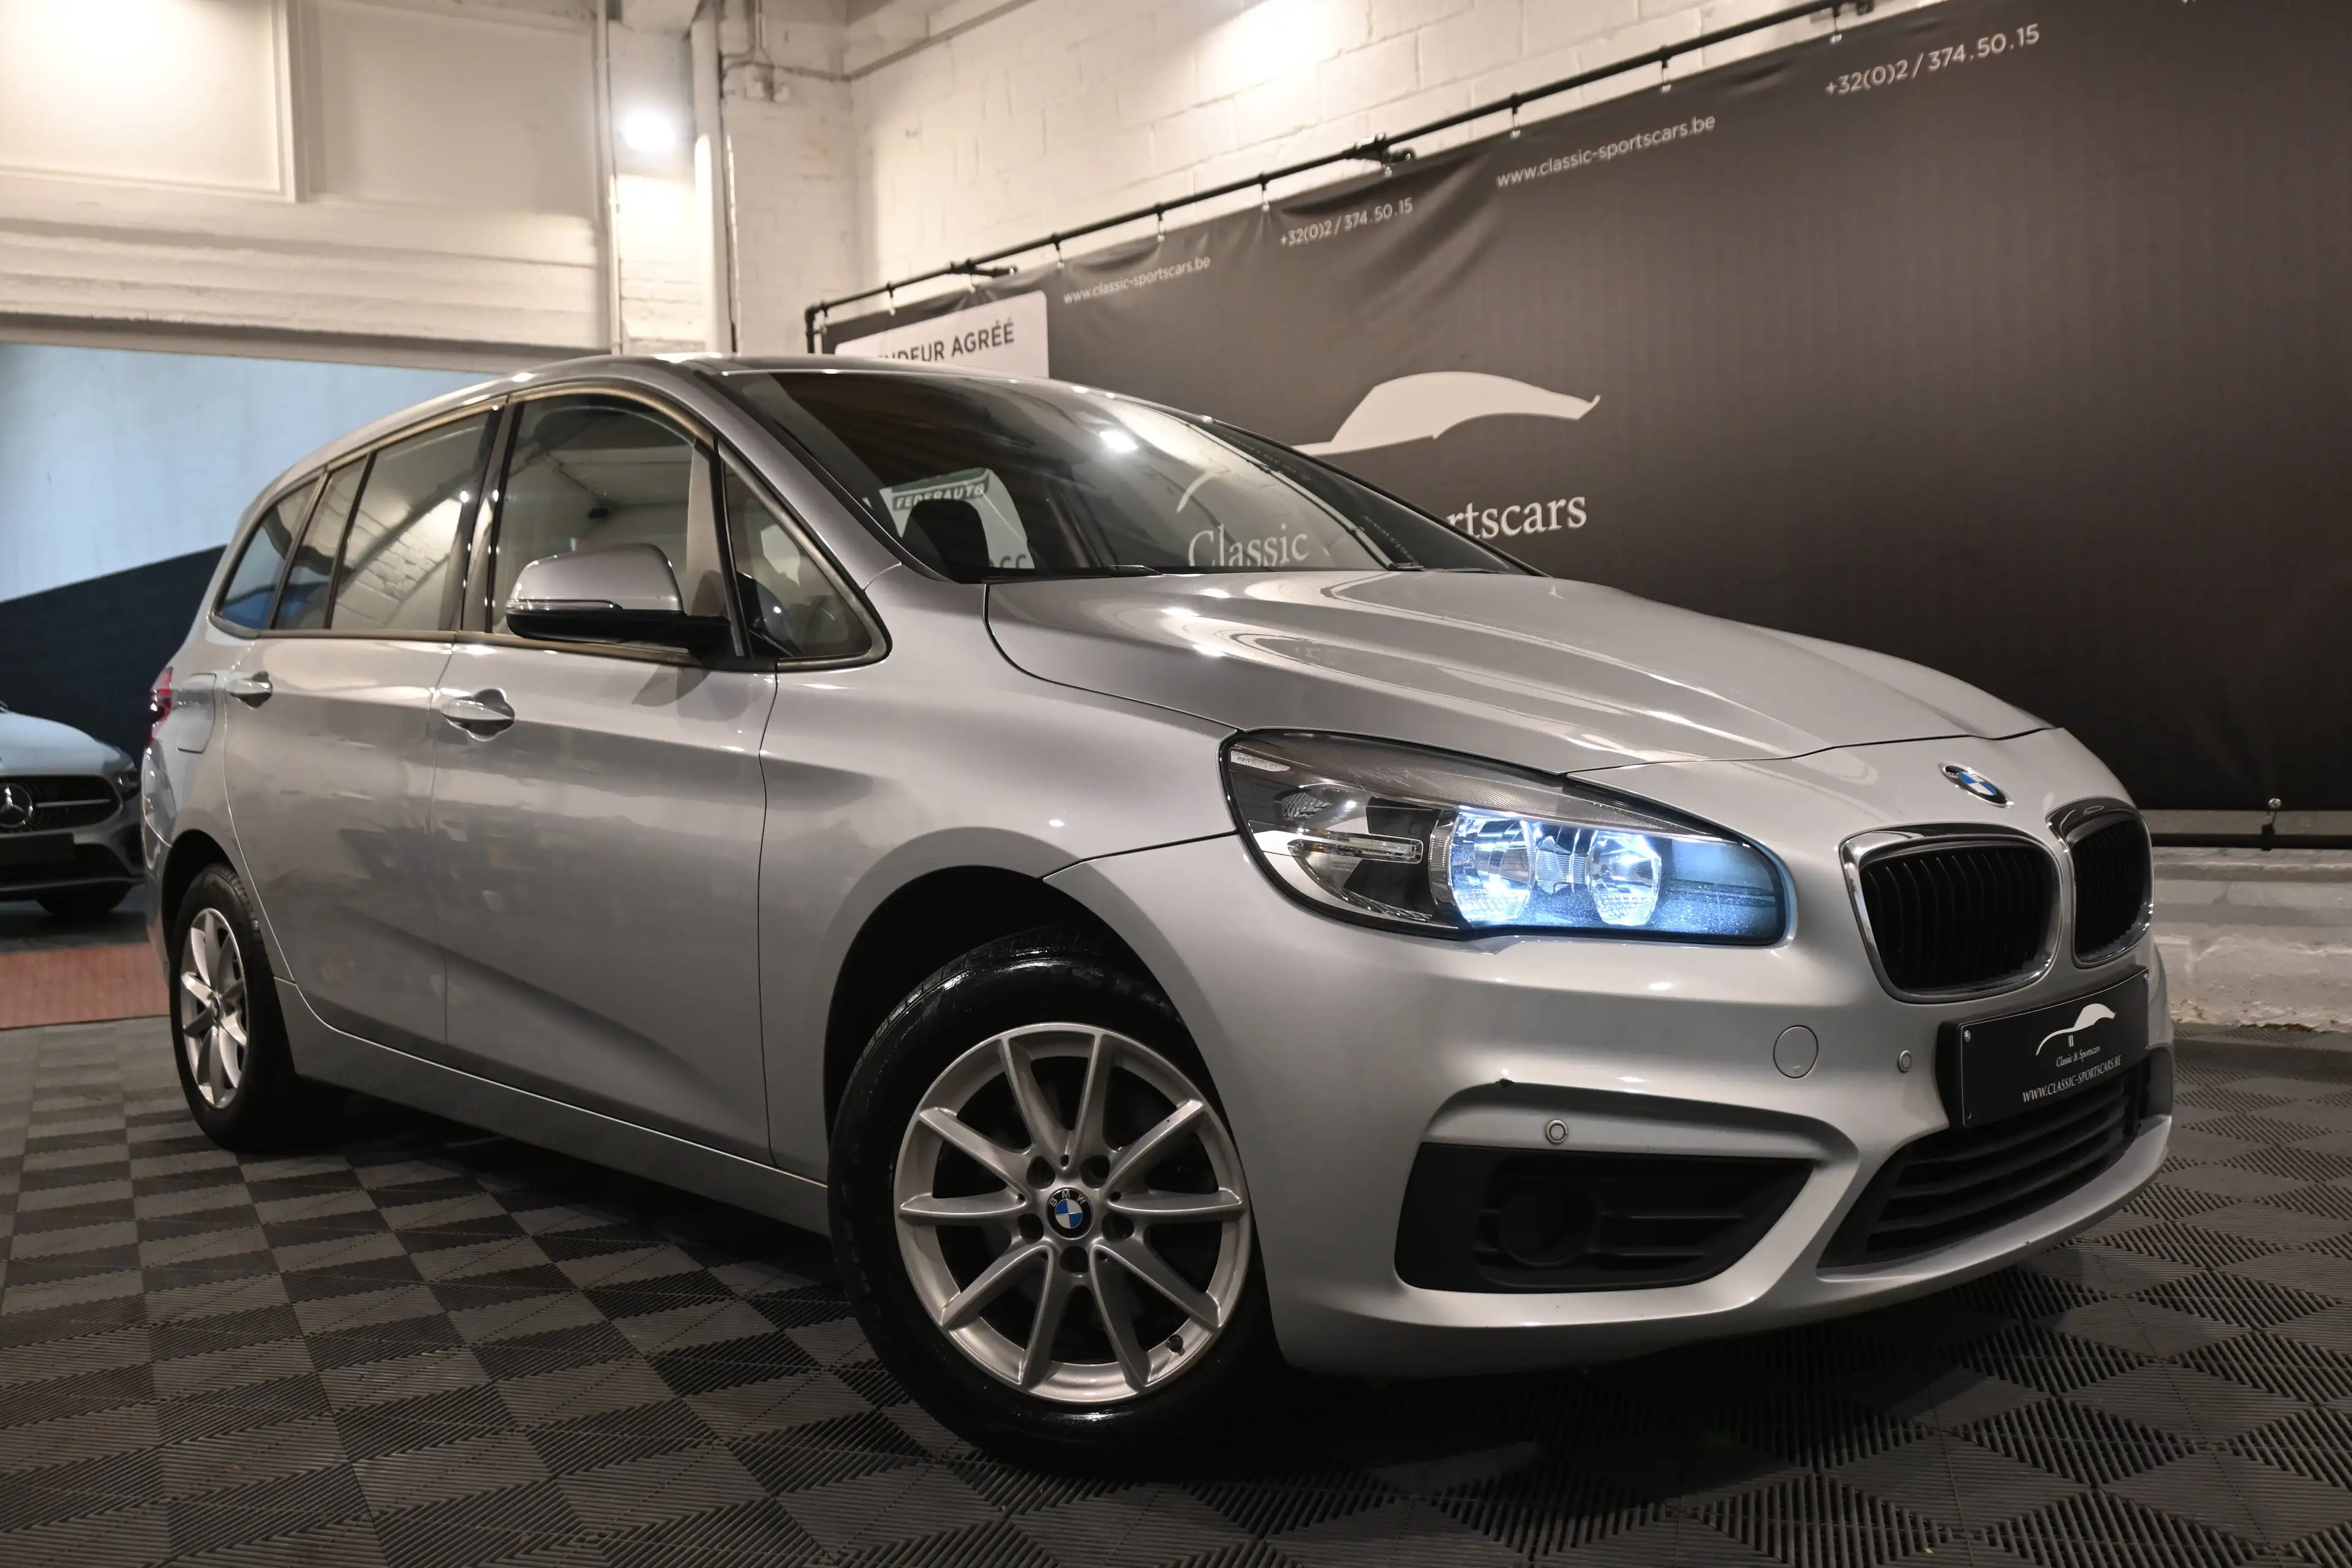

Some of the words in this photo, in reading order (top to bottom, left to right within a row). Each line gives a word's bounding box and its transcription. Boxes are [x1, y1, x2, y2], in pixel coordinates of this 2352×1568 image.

[1824, 59, 1908, 95] +32(0)2
[1496, 115, 1716, 188] www.classic-sportscars.be
[1063, 256, 1210, 304] www.classic-sportscars.be
[951, 317, 1015, 357] AGRÉÉ
[1189, 523, 1308, 567] Classic
[1446, 496, 1588, 540] rtscars
[1237, 755, 1251, 763] BMW
[2056, 1054, 2073, 1067] Classic
[2074, 1052, 2078, 1061] &
[2079, 1046, 2101, 1063] Sportscars
[2022, 1055, 2122, 1102] WWW.CLASSIC-SPORTSCARS.BE
[1050, 1190, 1086, 1208] BMW
